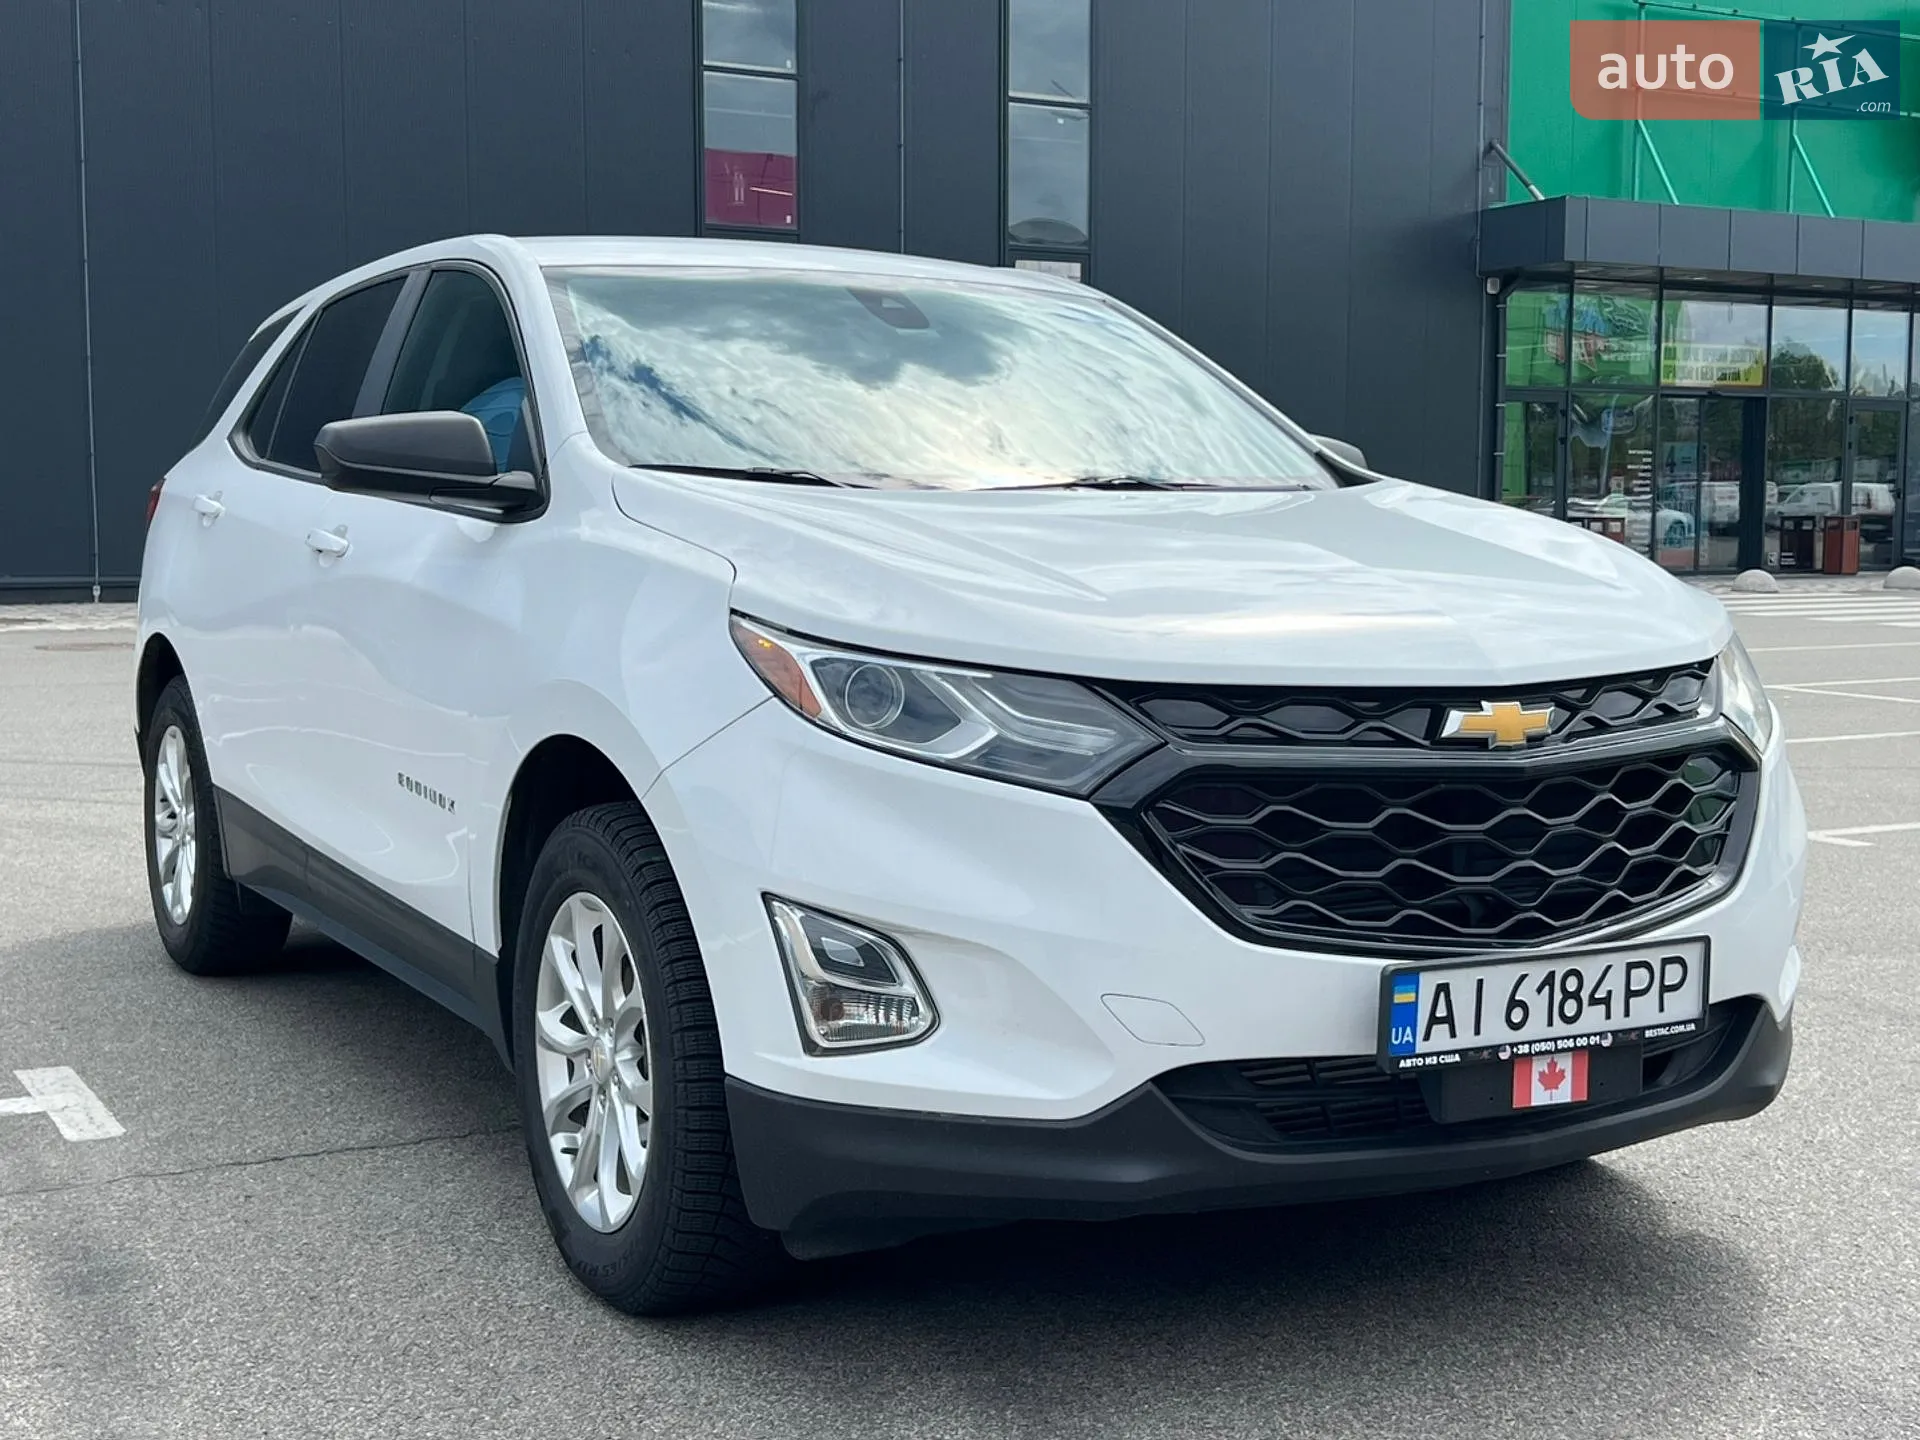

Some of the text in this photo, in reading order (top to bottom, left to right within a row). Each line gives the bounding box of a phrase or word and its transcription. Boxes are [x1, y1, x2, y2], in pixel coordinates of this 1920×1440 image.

[1391, 1026, 1414, 1046] UA
[1513, 1035, 1601, 1055] +38 (050) 506 00 01
[1399, 1053, 1461, 1069] АВТО ИЗ США
